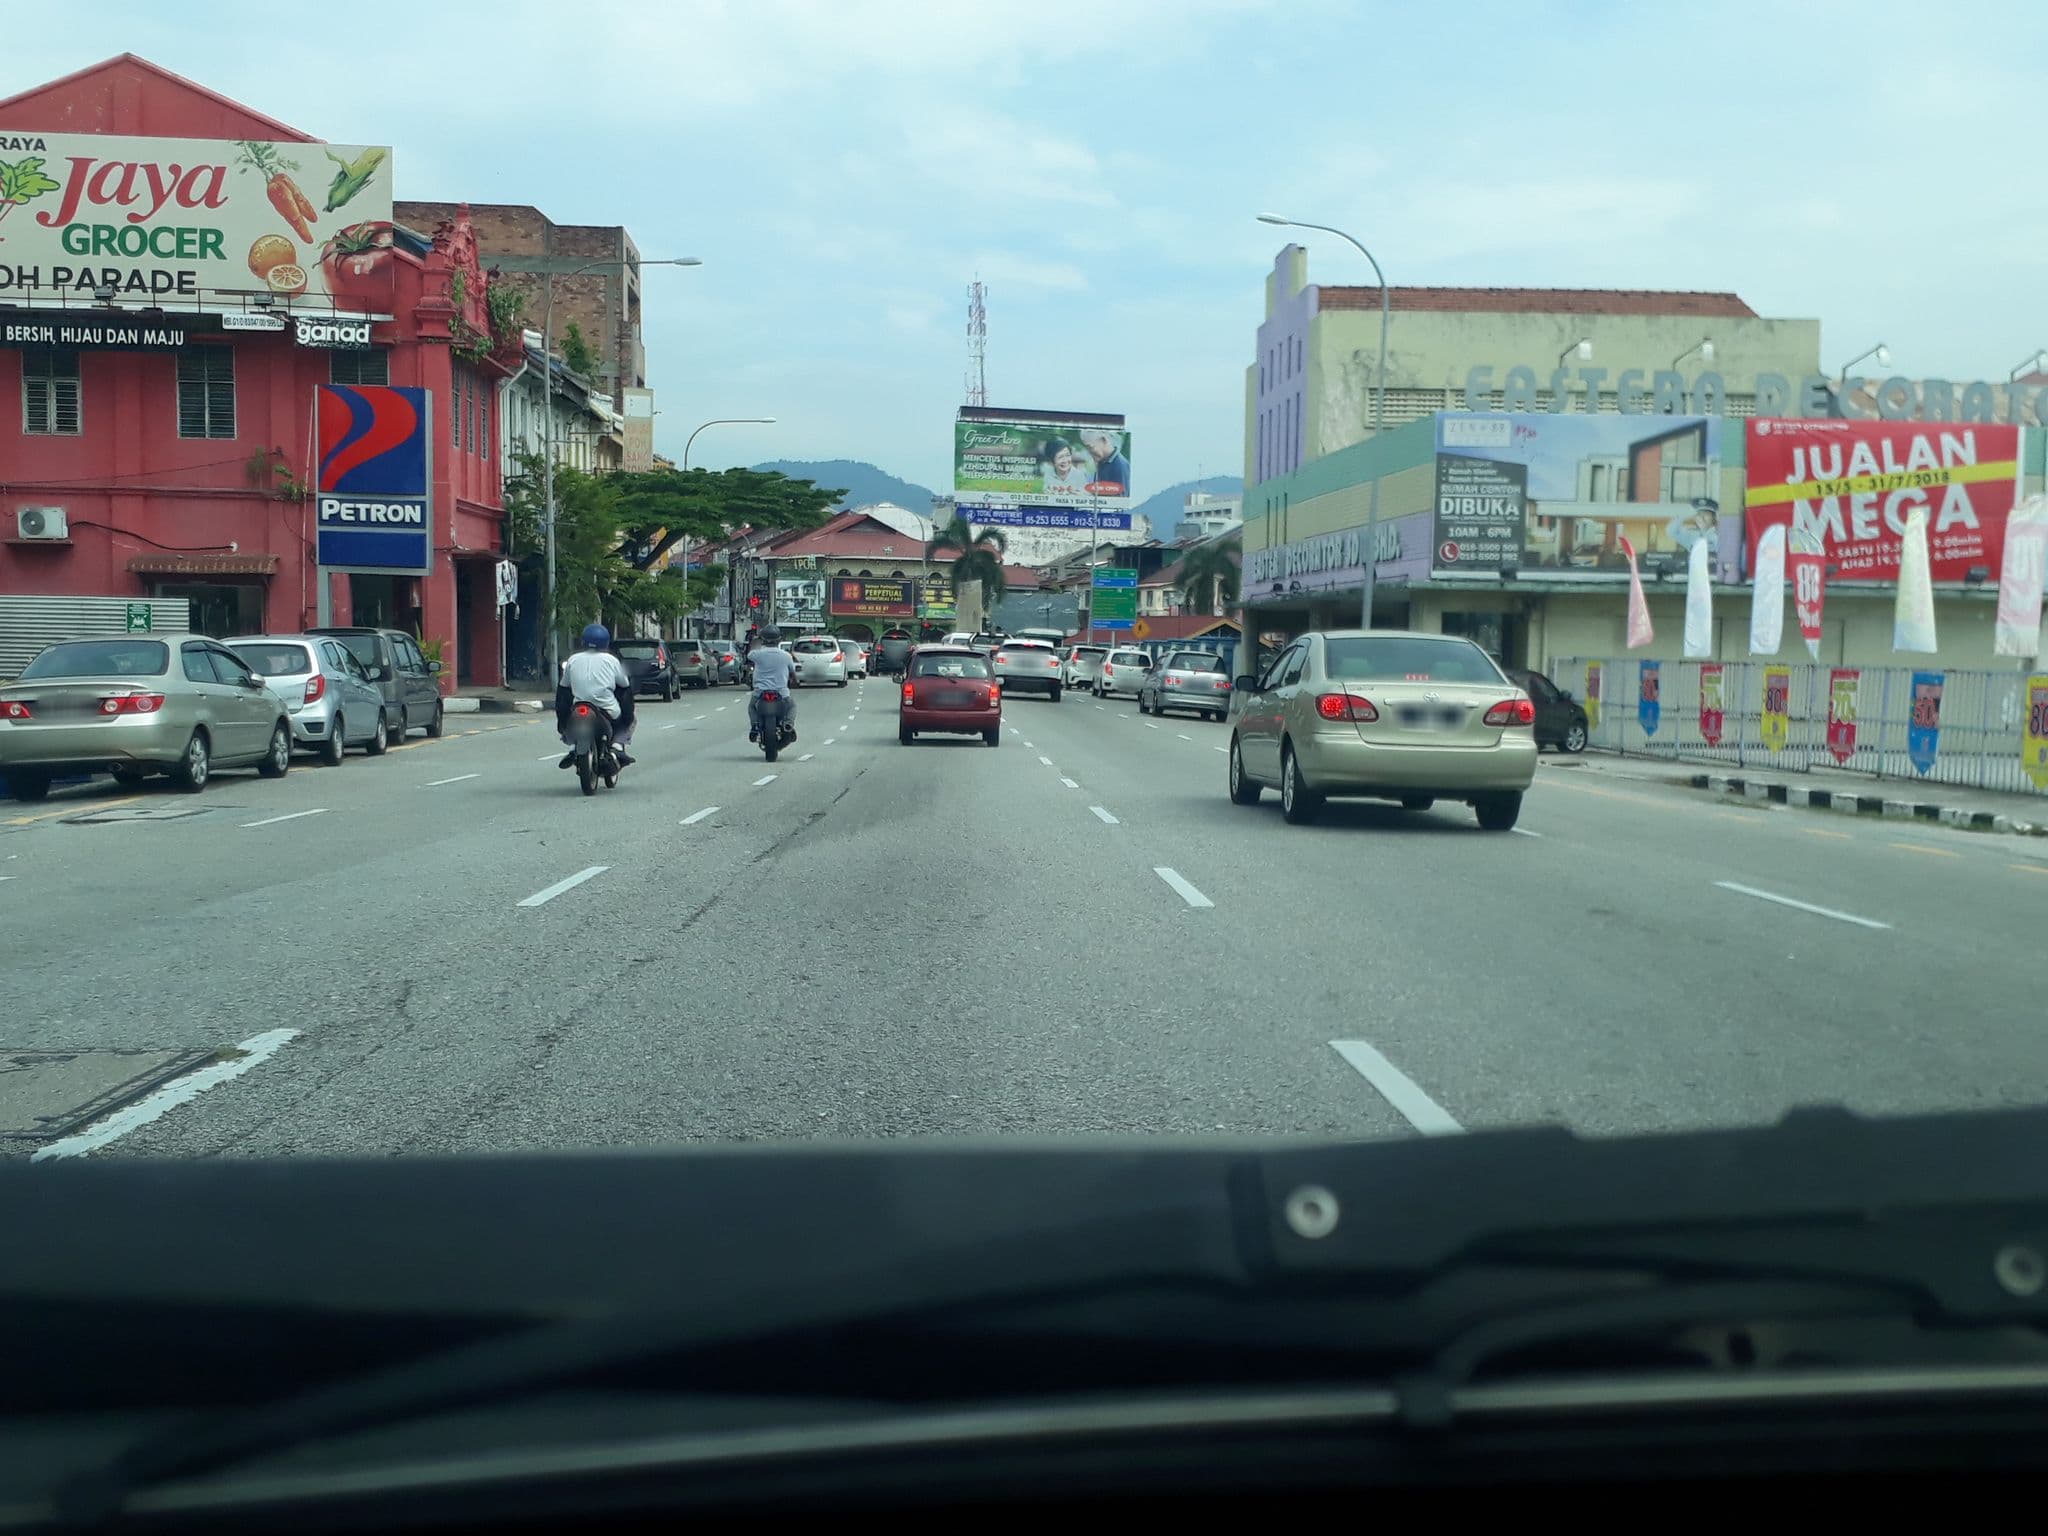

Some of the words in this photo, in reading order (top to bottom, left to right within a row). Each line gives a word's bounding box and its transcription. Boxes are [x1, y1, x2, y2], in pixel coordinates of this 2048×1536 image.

[36, 157, 229, 228] Jaya
[61, 223, 228, 260] GROCER
[52, 266, 197, 295] PARADE
[6, 325, 57, 345] BERSIH,
[61, 327, 102, 344] HIJAU
[106, 330, 138, 344] DAN
[143, 330, 185, 346] MAJU
[296, 323, 371, 345] ganad
[1786, 430, 1978, 484] JUALAN
[321, 499, 422, 524] PETRON
[1440, 498, 1520, 516] DIBUKA
[1793, 484, 1980, 544] MEGA
[1051, 516, 1069, 526] 6555
[864, 589, 903, 597] PERPETUAL
